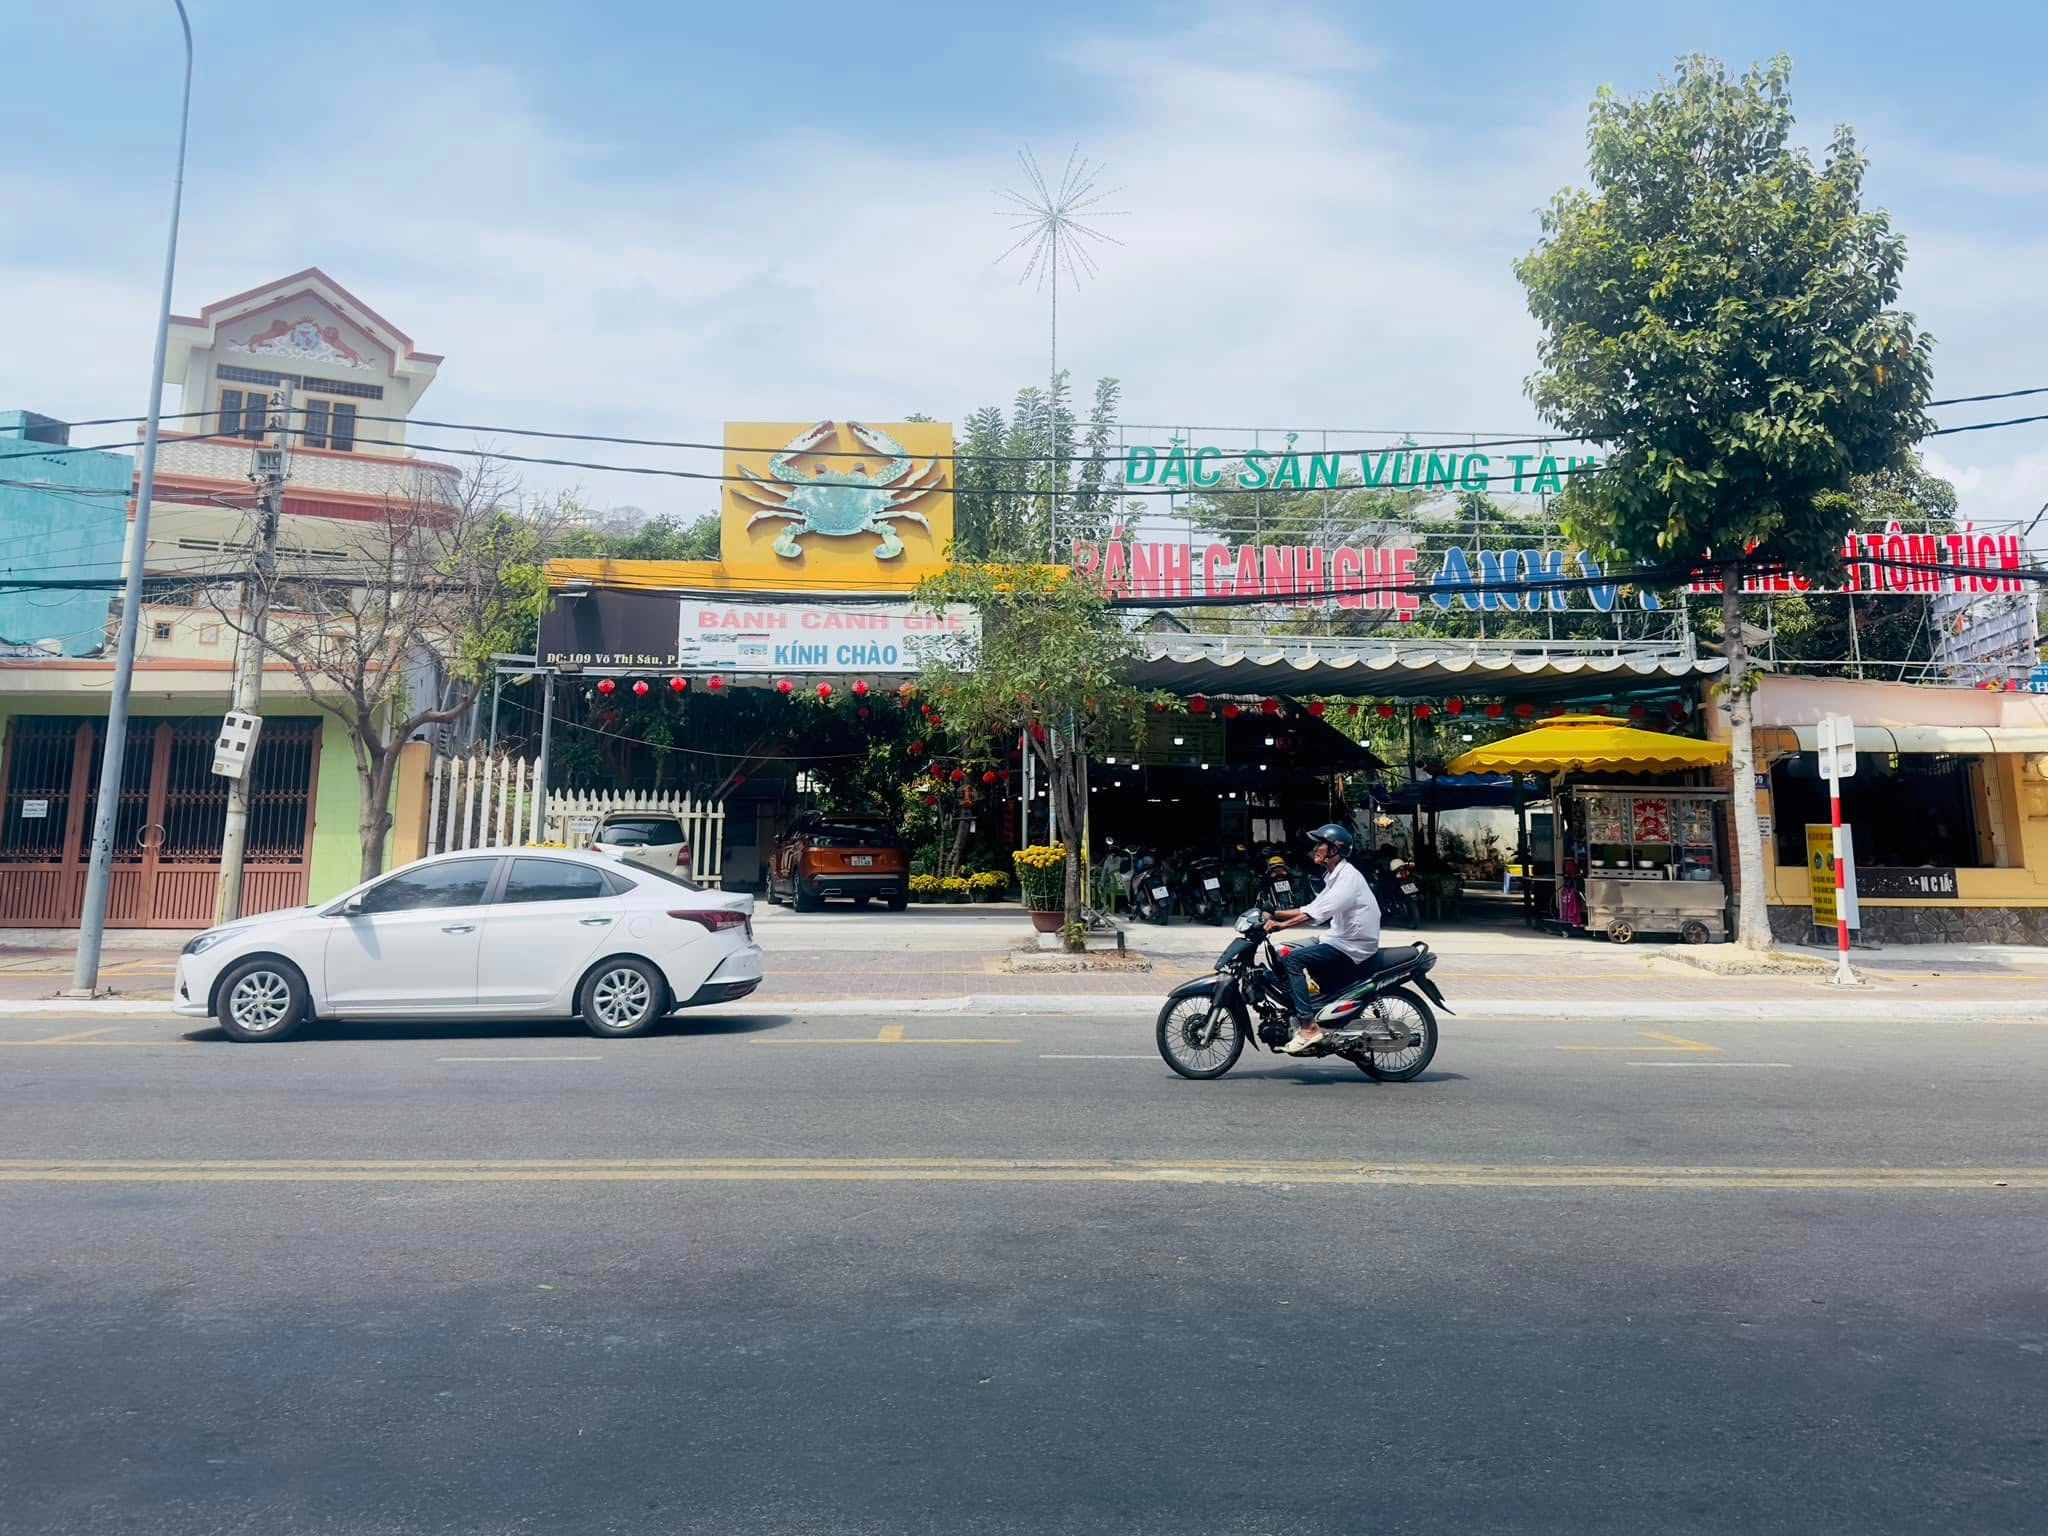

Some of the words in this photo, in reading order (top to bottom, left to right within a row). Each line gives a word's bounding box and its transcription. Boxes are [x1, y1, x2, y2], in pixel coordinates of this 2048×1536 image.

[1237, 431, 1352, 491] SẢN
[1203, 543, 1326, 608] CANH
[1331, 546, 1420, 624] GHẸ
[1429, 545, 1567, 612] ANH
[1865, 519, 1942, 593] TÔM
[1946, 520, 2025, 594] TÍCH
[698, 607, 788, 630] BÁNH
[800, 610, 891, 630] CANH
[775, 640, 828, 666] KÍNH
[836, 640, 897, 667] CHÀO
